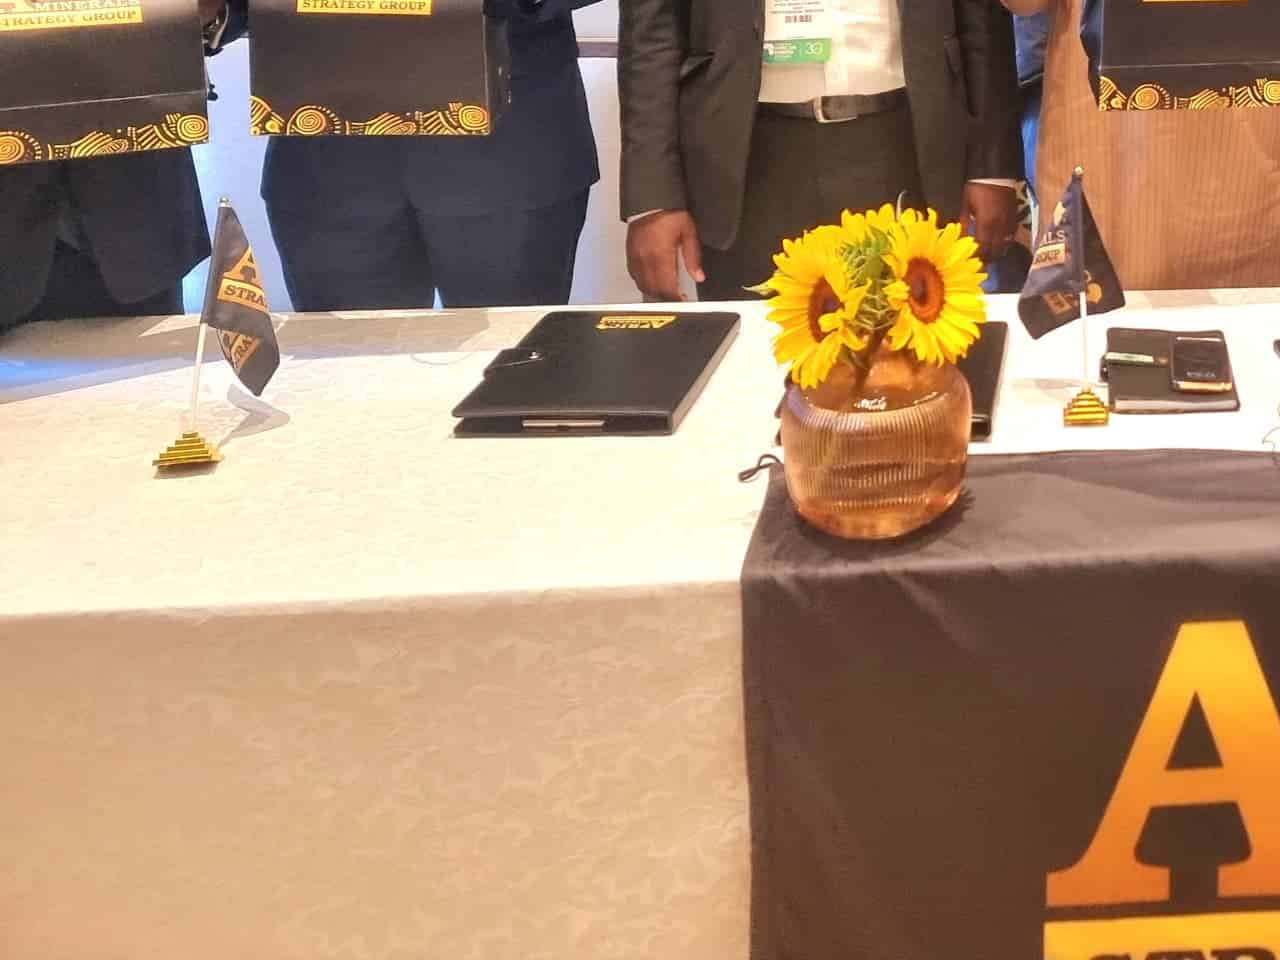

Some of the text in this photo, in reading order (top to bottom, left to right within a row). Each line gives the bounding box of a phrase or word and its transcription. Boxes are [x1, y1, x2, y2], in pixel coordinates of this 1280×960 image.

[303, 0, 427, 11] STRATEGY GROUP
[0, 10, 137, 27] TRATEGY GROUP
